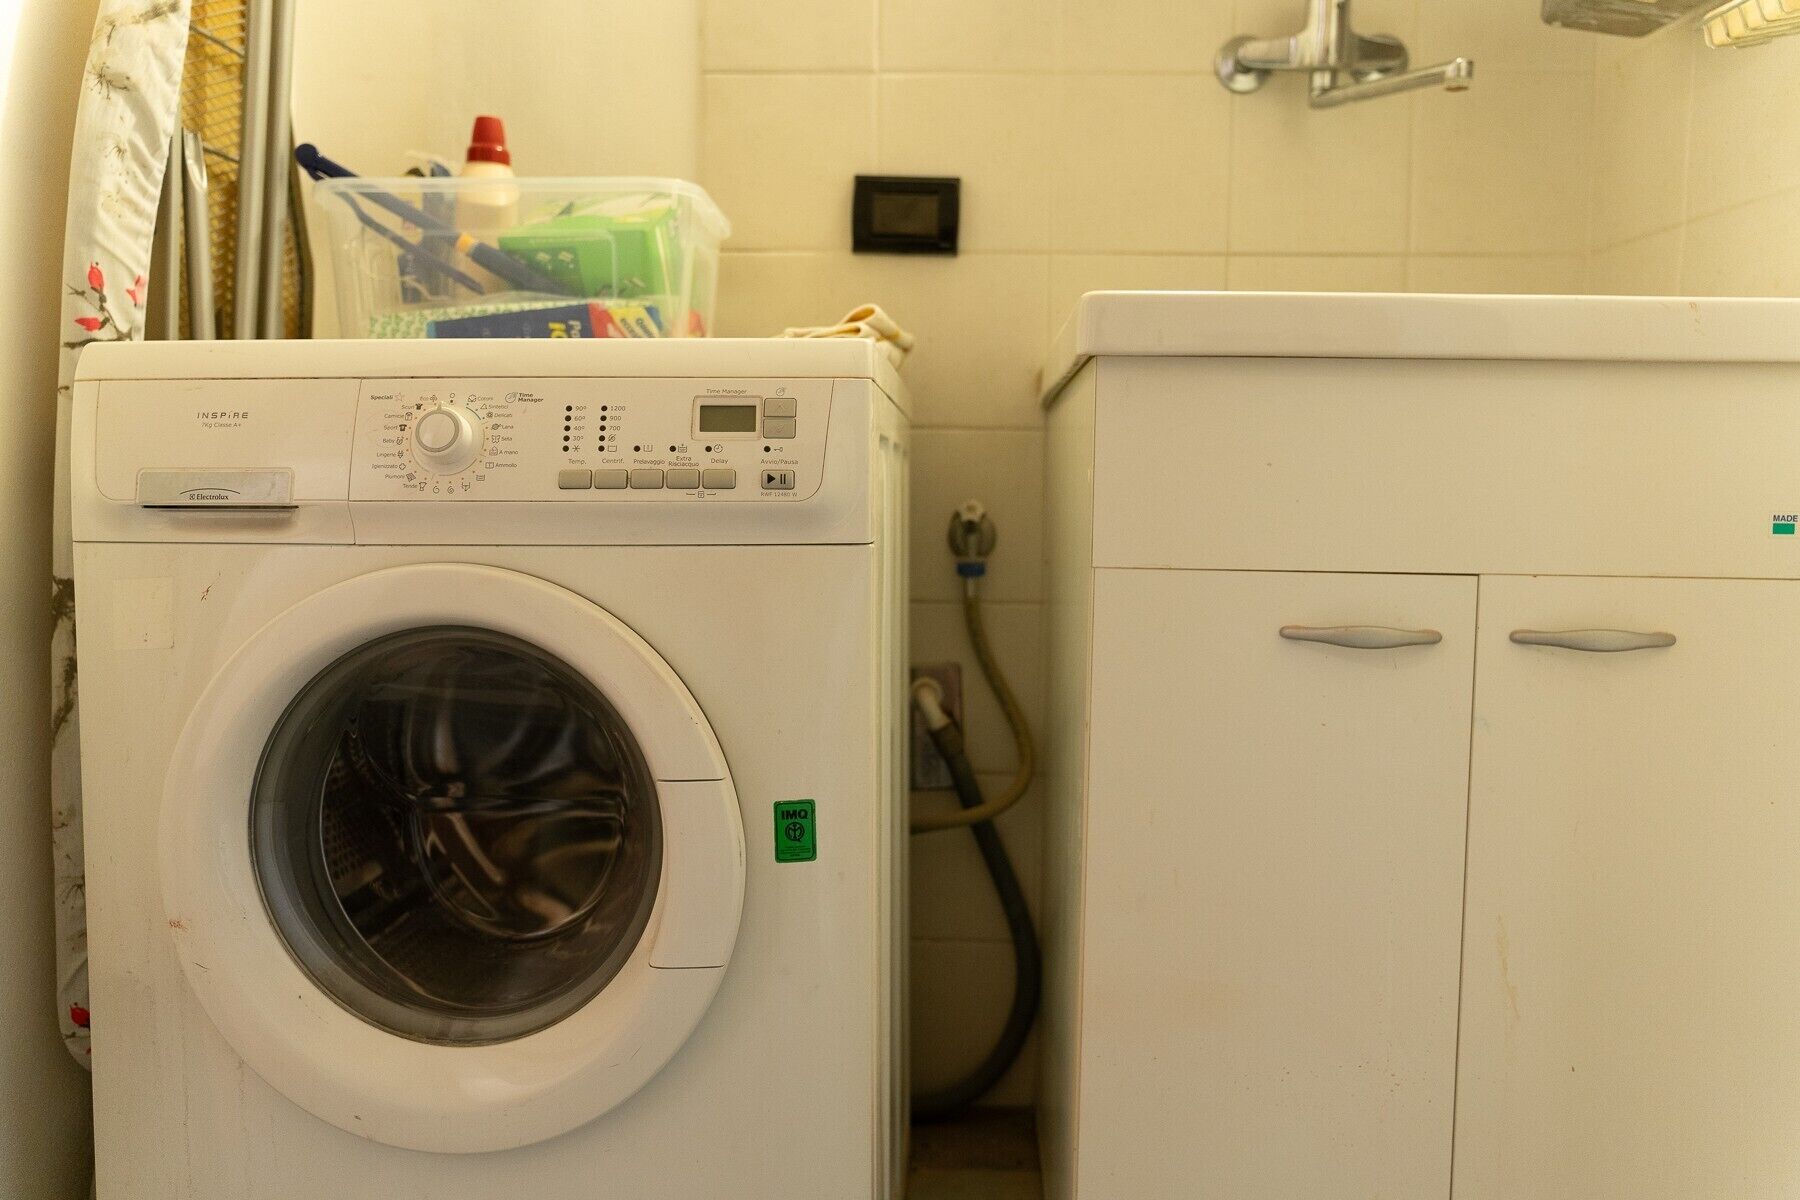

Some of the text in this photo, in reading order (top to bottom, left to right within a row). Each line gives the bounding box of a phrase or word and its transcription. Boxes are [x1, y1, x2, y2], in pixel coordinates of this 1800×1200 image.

[633, 458, 666, 466] Prelavaggio
[710, 457, 729, 465] Delay
[760, 458, 799, 466] Avvio/Pausa
[1773, 514, 1799, 522] MADE
[782, 808, 808, 820] IMQ
